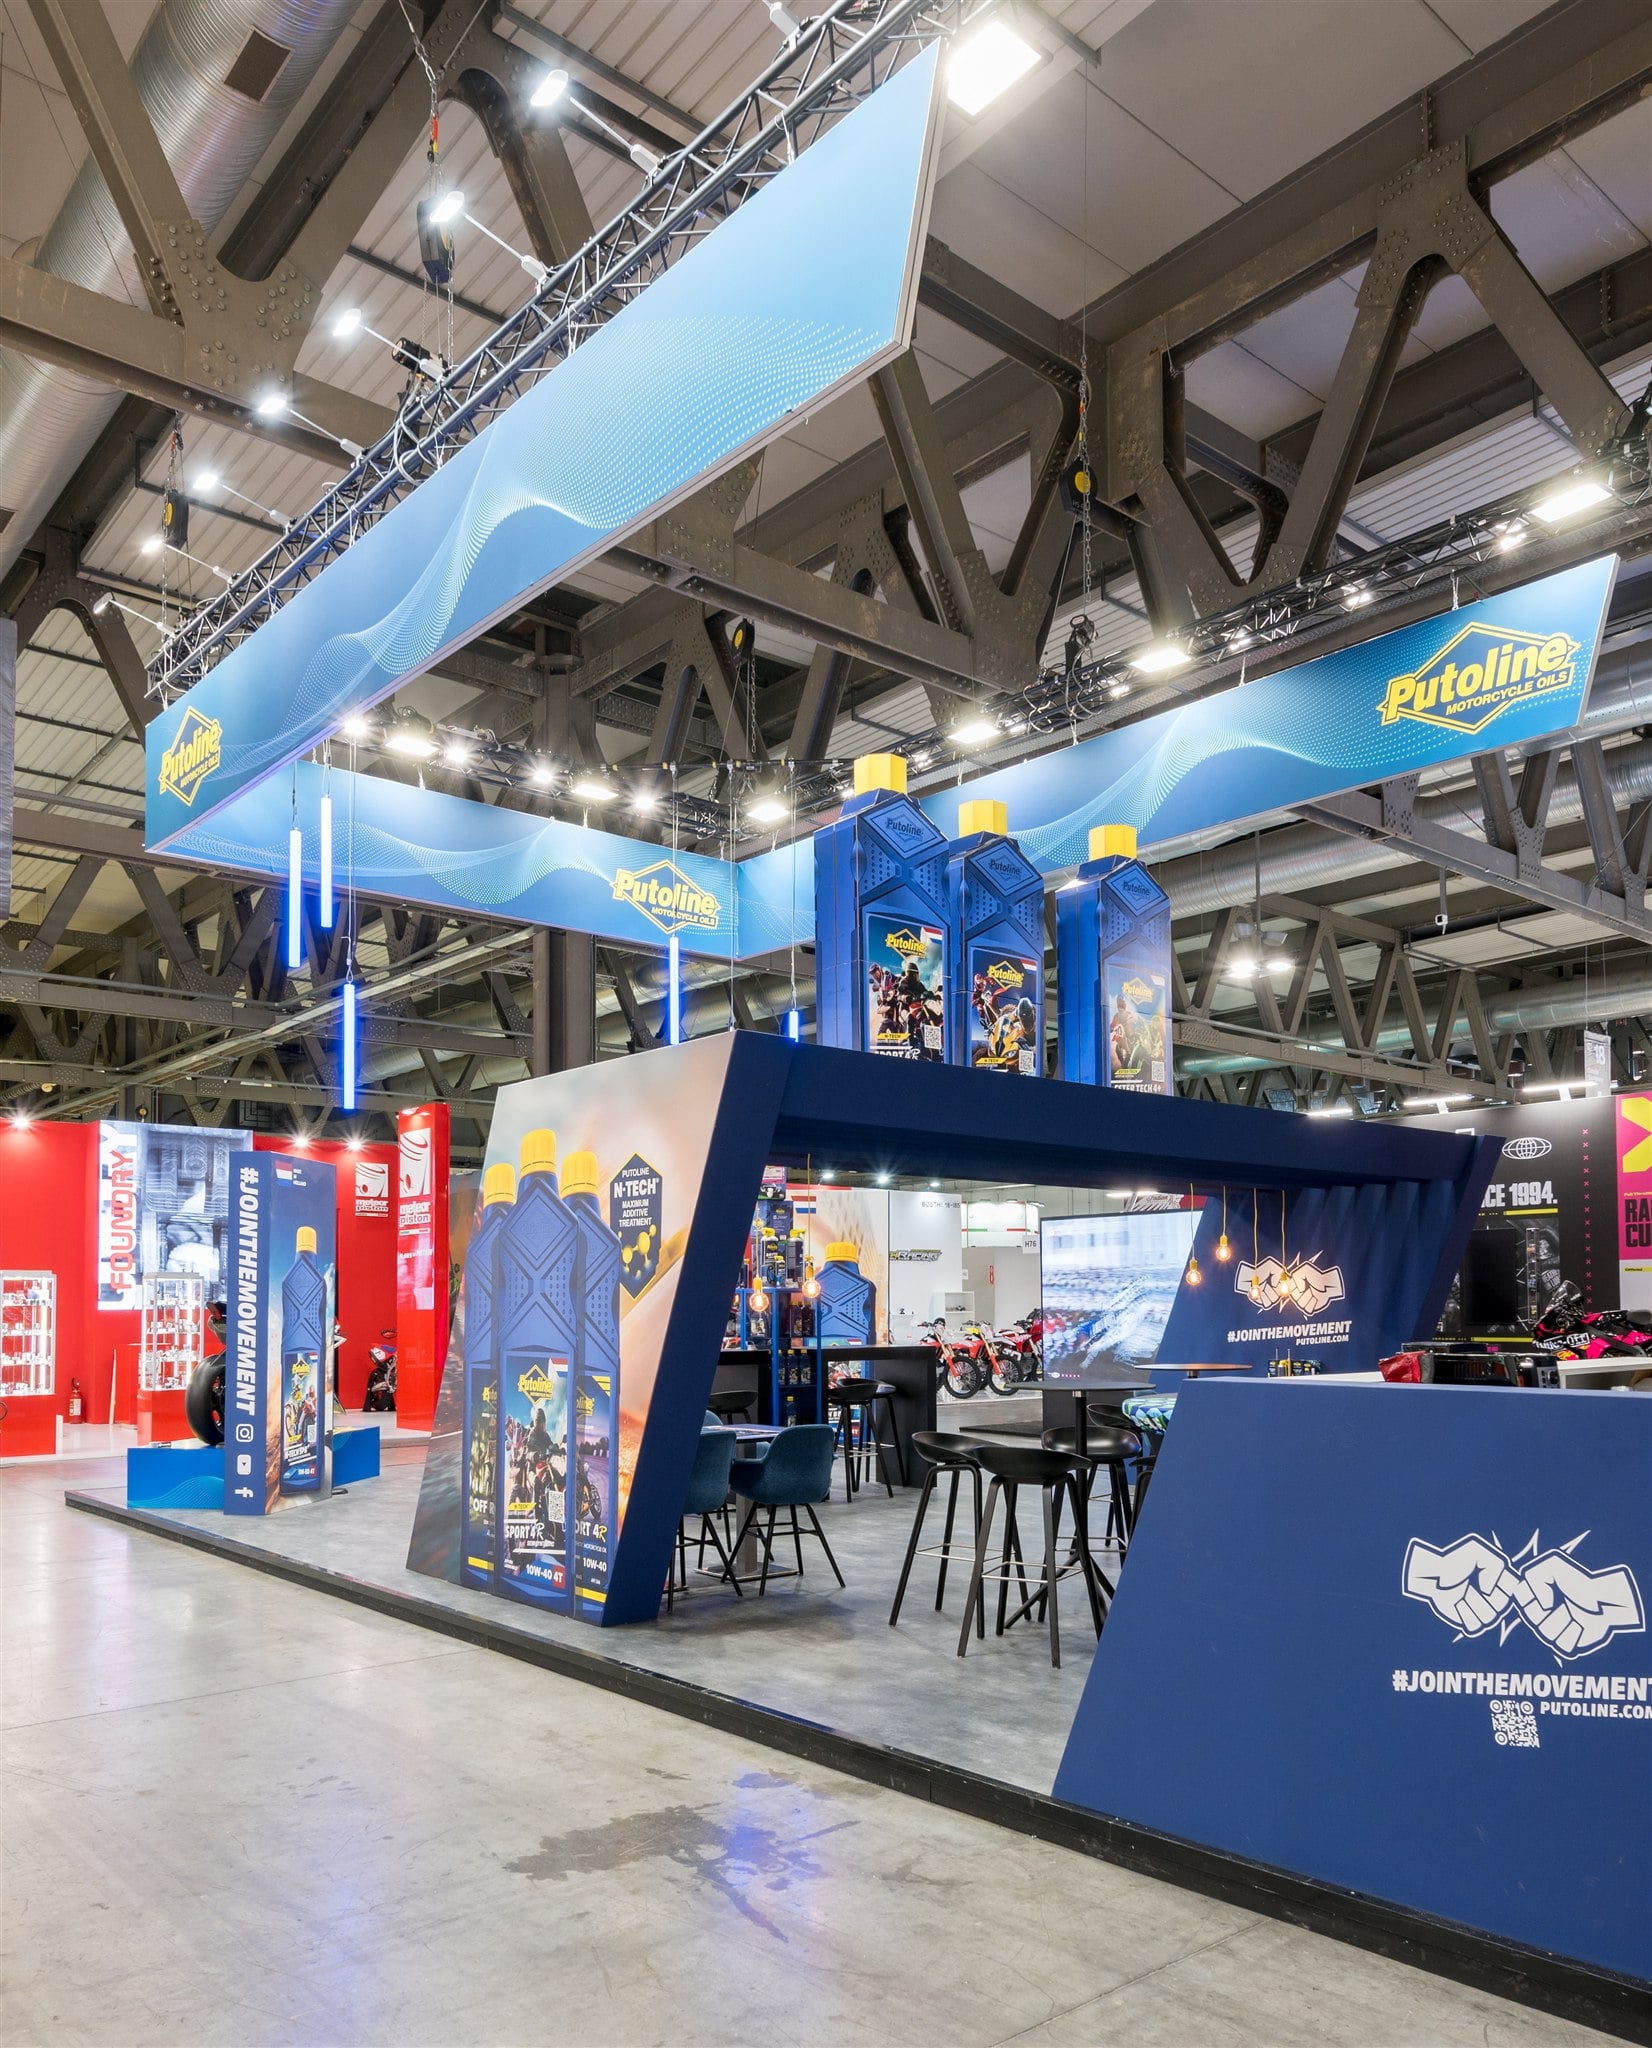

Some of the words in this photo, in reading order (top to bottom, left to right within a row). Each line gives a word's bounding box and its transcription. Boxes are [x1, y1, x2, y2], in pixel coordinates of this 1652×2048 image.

[1383, 635, 1570, 722] Putoline
[1445, 681, 1534, 716] MOTORCYCLE
[1536, 670, 1568, 690] OILS
[160, 722, 220, 792] Putoline
[887, 817, 923, 836] Putoline
[989, 858, 1022, 875] Putoline
[615, 870, 716, 916] Putoline
[1122, 881, 1151, 896] Putoline
[651, 908, 699, 922] MOTORCYCLE
[700, 915, 716, 925] OILS
[886, 934, 925, 952] Putoline
[989, 965, 1023, 982] Putoline
[1122, 981, 1153, 997] Putoline
[1594, 1044, 1606, 1065] 18
[622, 1166, 650, 1178] PUTOLINE
[1508, 1180, 1559, 1207] 1994.
[622, 1198, 649, 1209] MAXIMUM
[1625, 1198, 1652, 1223] RA
[109, 1150, 134, 1291] FOUNDRY
[400, 1214, 430, 1228] piston
[622, 1208, 649, 1218] ADDITIVE
[619, 1217, 652, 1228] TREATMENT
[1024, 1240, 1037, 1248] H76
[236, 1167, 259, 1416] #JOINTHEMOVEMENT
[1227, 1320, 1353, 1343] #JOINTHEMOVEMENT
[1296, 1334, 1349, 1346] PUTOLINE.COM
[518, 1376, 553, 1392] Putoline
[472, 1498, 488, 1513] OFF
[504, 1525, 530, 1539] SPORT
[526, 1563, 553, 1580] 10W-40
[553, 1571, 564, 1584] 4T
[583, 1557, 607, 1573] 10W-40
